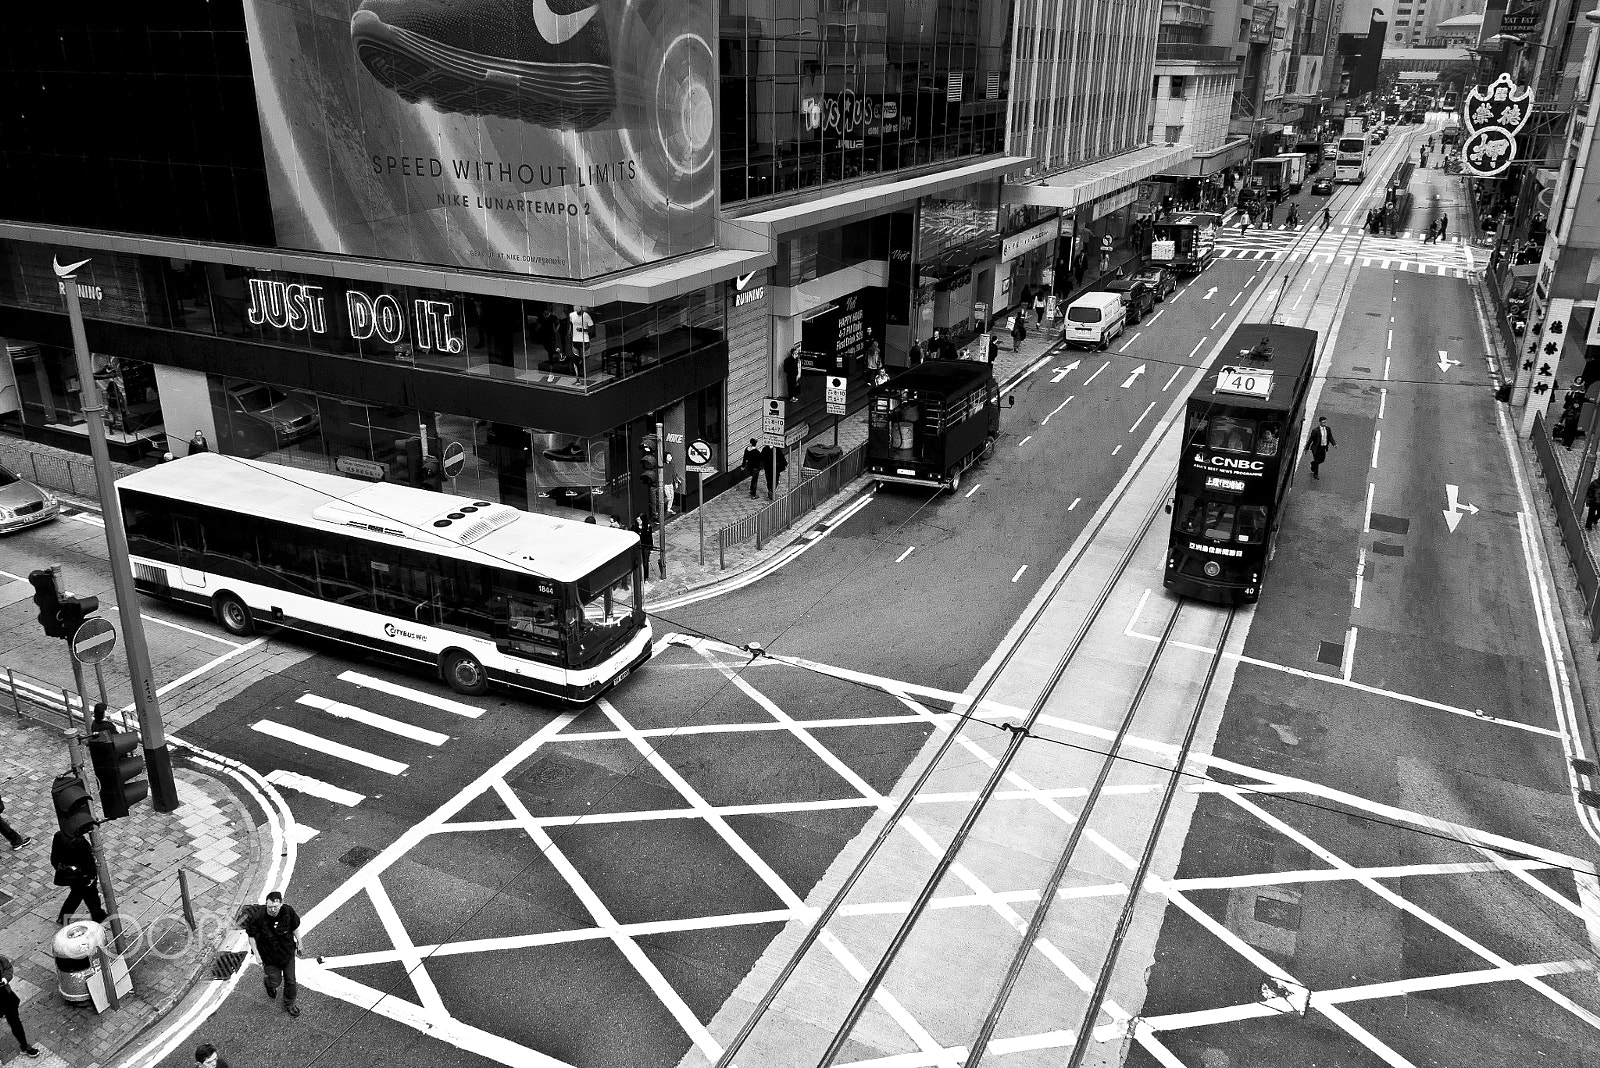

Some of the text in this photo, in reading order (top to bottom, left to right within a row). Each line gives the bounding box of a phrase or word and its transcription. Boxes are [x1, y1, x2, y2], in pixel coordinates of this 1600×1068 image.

[1503, 16, 1519, 24] YAT
[373, 158, 636, 187] SPEED WITHOUT LIMITS
[437, 193, 590, 216] NIKE LUNARTEMPO 2
[58, 281, 103, 301] RNING
[735, 286, 764, 307] RUNNING
[248, 279, 464, 354] JUST DO IT.
[1232, 376, 1255, 391] 40
[666, 433, 683, 444] NIKE
[1211, 456, 1264, 471] CNBC
[538, 584, 554, 595] 1844
[1244, 587, 1255, 595] 40
